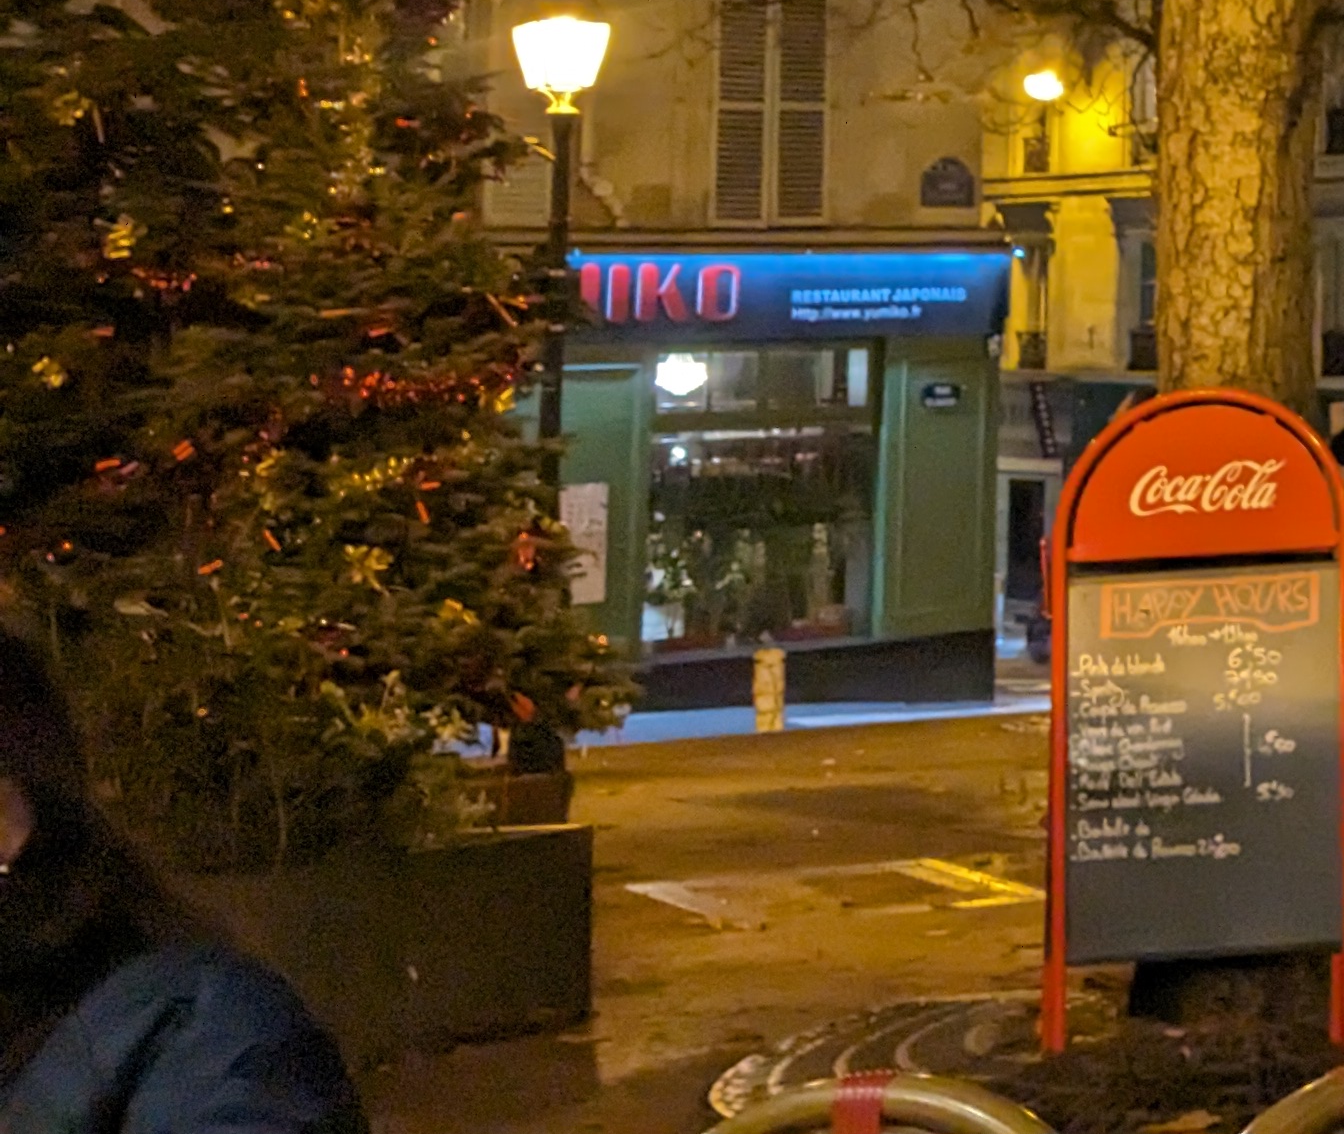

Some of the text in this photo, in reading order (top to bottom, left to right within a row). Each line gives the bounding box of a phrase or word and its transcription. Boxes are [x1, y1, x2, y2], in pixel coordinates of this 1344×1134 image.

[790, 286, 967, 304] RESTAURANT JAPONAIS
[1128, 458, 1288, 517] Coca-Cola
[1113, 580, 1310, 628] HAPPY HOURS
